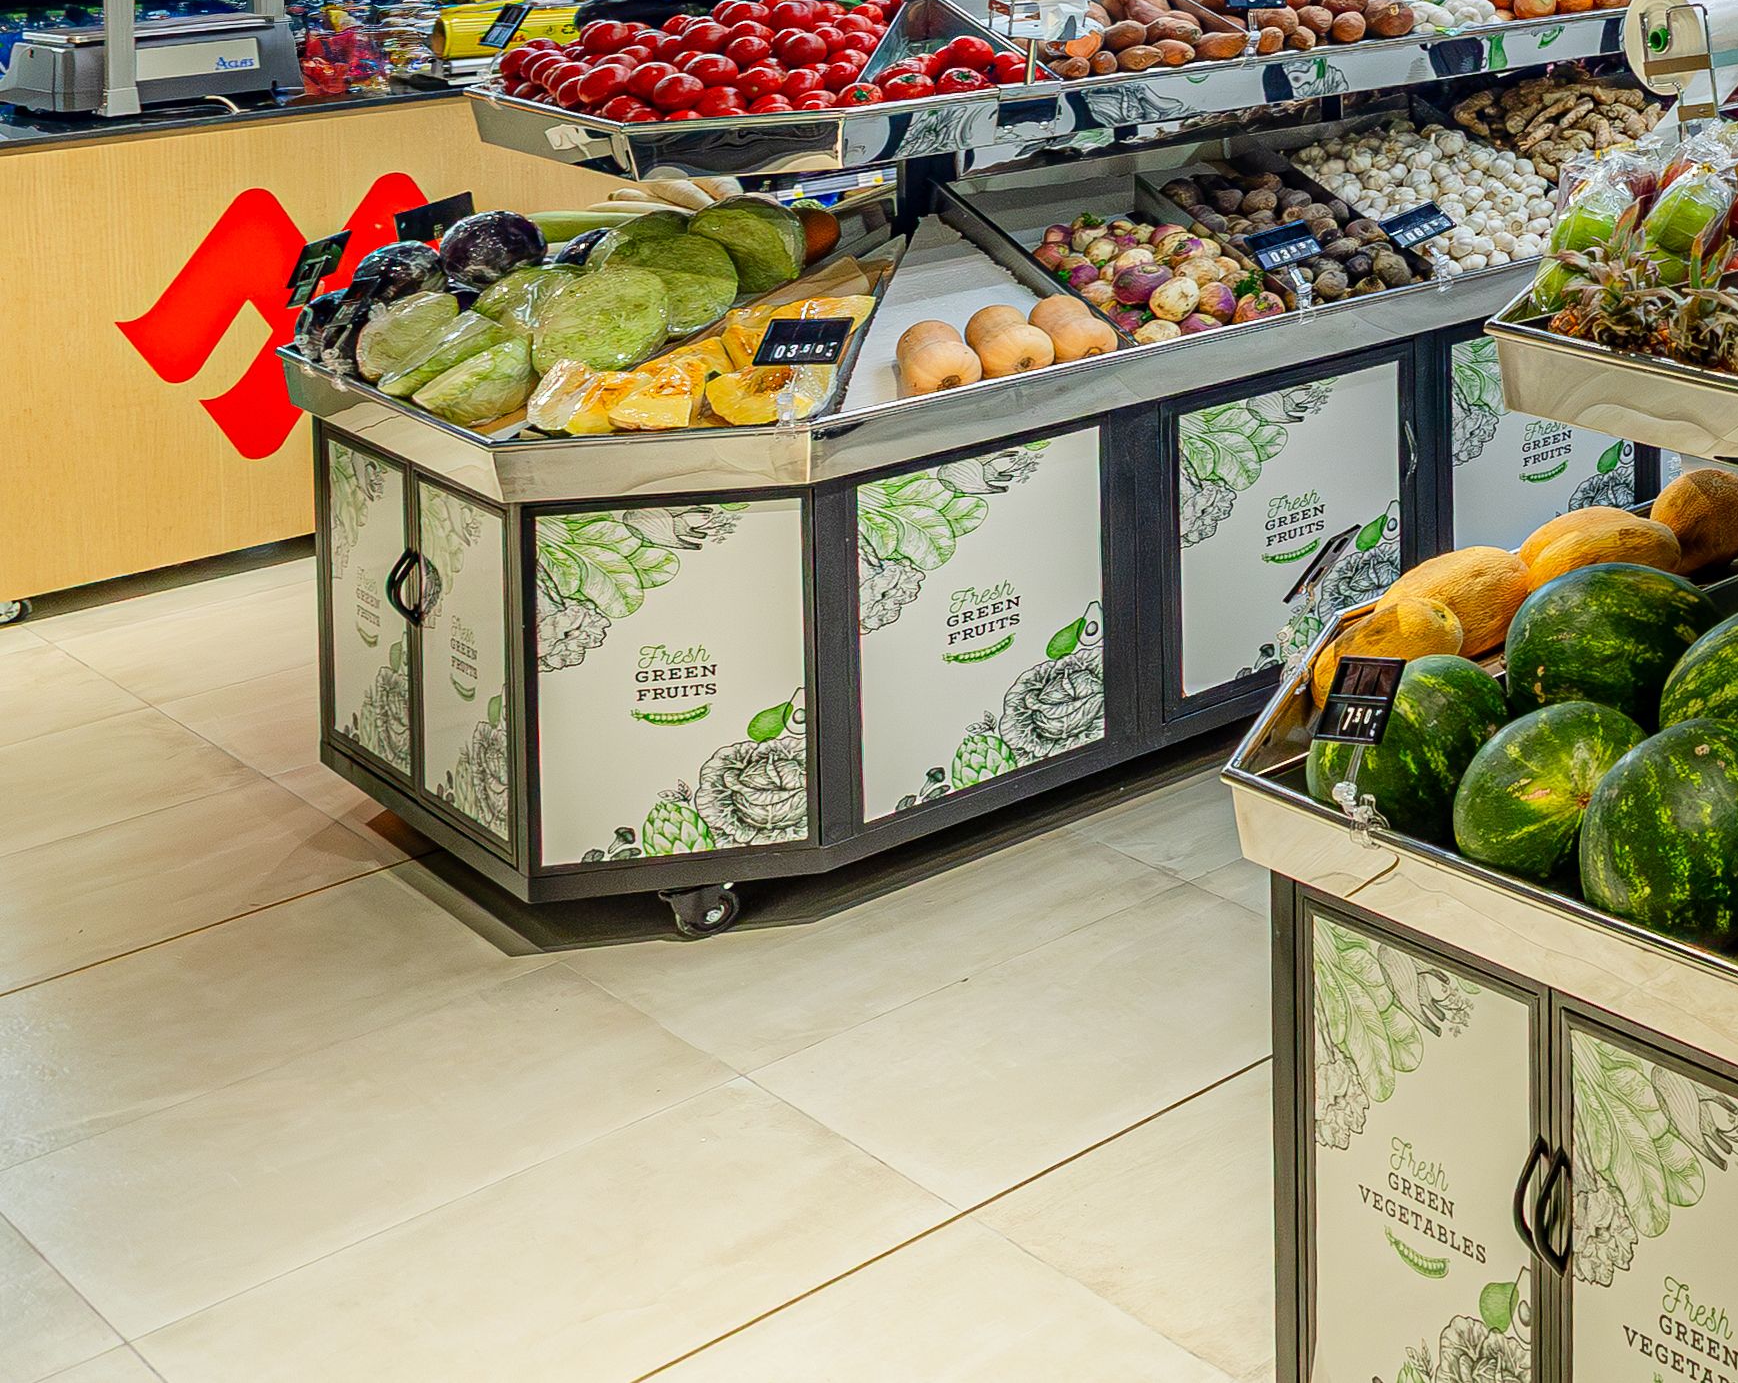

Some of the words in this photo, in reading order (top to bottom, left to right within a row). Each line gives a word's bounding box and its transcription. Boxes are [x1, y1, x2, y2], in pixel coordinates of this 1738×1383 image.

[1522, 430, 1572, 452] GREEN
[1522, 444, 1572, 468] FRUITS
[1265, 504, 1326, 531] GREEN
[1267, 489, 1321, 518] Fresh
[1265, 520, 1325, 547] FRUITS
[949, 579, 1015, 614] Fresh
[946, 596, 1020, 627] GREEN
[947, 614, 1021, 645] FRUITS
[638, 644, 711, 668] Fresh
[635, 664, 717, 683] GREEN
[636, 683, 717, 702] FRUITS
[1390, 1136, 1449, 1192] Fresh
[1387, 1172, 1455, 1219] GREEN
[1358, 1184, 1487, 1265] VEGETABLES
[1662, 1275, 1733, 1341] Fresh
